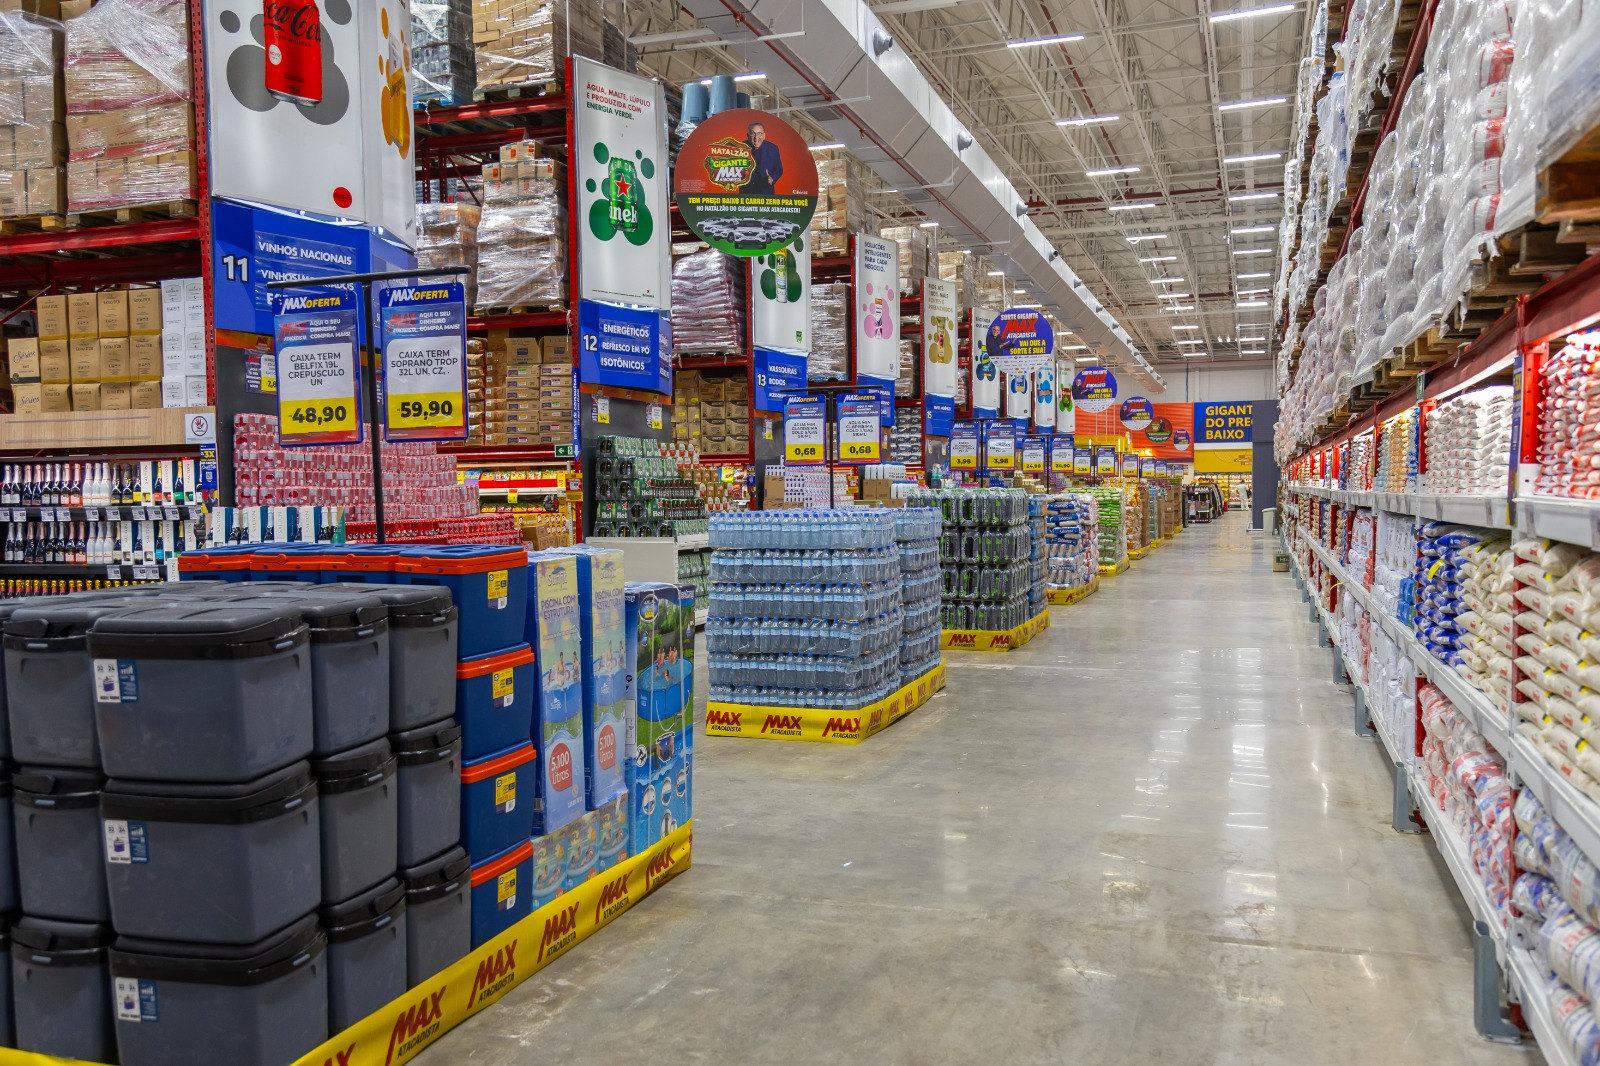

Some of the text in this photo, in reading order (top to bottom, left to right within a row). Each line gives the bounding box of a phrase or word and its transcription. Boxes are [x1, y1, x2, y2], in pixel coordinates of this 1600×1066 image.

[586, 82, 650, 108] ÁGUA, MALTE, LÚPULO
[592, 93, 627, 109] PRODUZIDA
[628, 104, 642, 114] COM
[586, 102, 634, 120] ENERGIA VERDE.
[711, 147, 750, 158] NATALZÃO
[713, 159, 748, 168] GIGANTE
[715, 166, 743, 182] MAX
[702, 198, 720, 206] PREÇO
[766, 198, 780, 206] ZERO
[864, 240, 886, 251] SOLUÇÕES
[864, 248, 892, 260] INTELIGENTES
[222, 241, 352, 283] 11 VINHOS NACIONAIS
[386, 312, 419, 334] MAX
[1017, 312, 1038, 320] GIGANTE
[1002, 318, 1038, 338] MAX
[310, 332, 334, 340] COMPRA
[583, 322, 650, 351] 12 ENERGÉTICOS
[398, 350, 450, 359] CAIXA TERM
[602, 341, 650, 354] REFRESCO EM PÓ
[290, 352, 341, 362] CAIXA TERM
[391, 358, 458, 368] SOPRANO TROP
[601, 356, 645, 370] ISOTÔNICOS
[294, 360, 338, 370] BELFIX 19L
[398, 368, 412, 376] 32L
[416, 368, 430, 376] UN,
[288, 369, 345, 379] CREPUSCULO
[757, 364, 798, 387] 13 VASSOURAS
[1083, 374, 1107, 388] MAX
[310, 378, 323, 386] UN
[768, 378, 786, 386] RODOS
[292, 406, 347, 426] 48,90
[400, 400, 453, 420] 59,90
[1206, 417, 1252, 428] DO PRE
[1206, 429, 1244, 440] BAIXO
[794, 448, 816, 456] 0,68
[850, 446, 871, 455] 0,68
[595, 588, 622, 600] PISCINA COM
[541, 595, 576, 609] PISCINA COM
[597, 598, 621, 610] ESTRUTURA
[544, 606, 574, 620] ESTRUTURA
[948, 634, 977, 646] MAX
[706, 710, 742, 726] MAX
[887, 699, 899, 724] MAX
[761, 714, 802, 734] MAX
[822, 717, 861, 737] MAX
[866, 708, 883, 733] MAX
[710, 724, 742, 733] ATACADISTA
[599, 732, 614, 748] 5.100
[551, 752, 570, 769] 5.100
[552, 770, 570, 785] litros
[645, 843, 676, 891] MAX
[595, 870, 633, 924] MAX
[603, 896, 629, 920] ATACADISTA
[536, 902, 579, 963] MAX
[547, 932, 576, 957] ATACADISTA
[467, 940, 517, 1009] MAX
[478, 972, 515, 1004] ATACADISTA
[385, 985, 447, 1066] MAX
[398, 1021, 440, 1059] ATACADISTA
